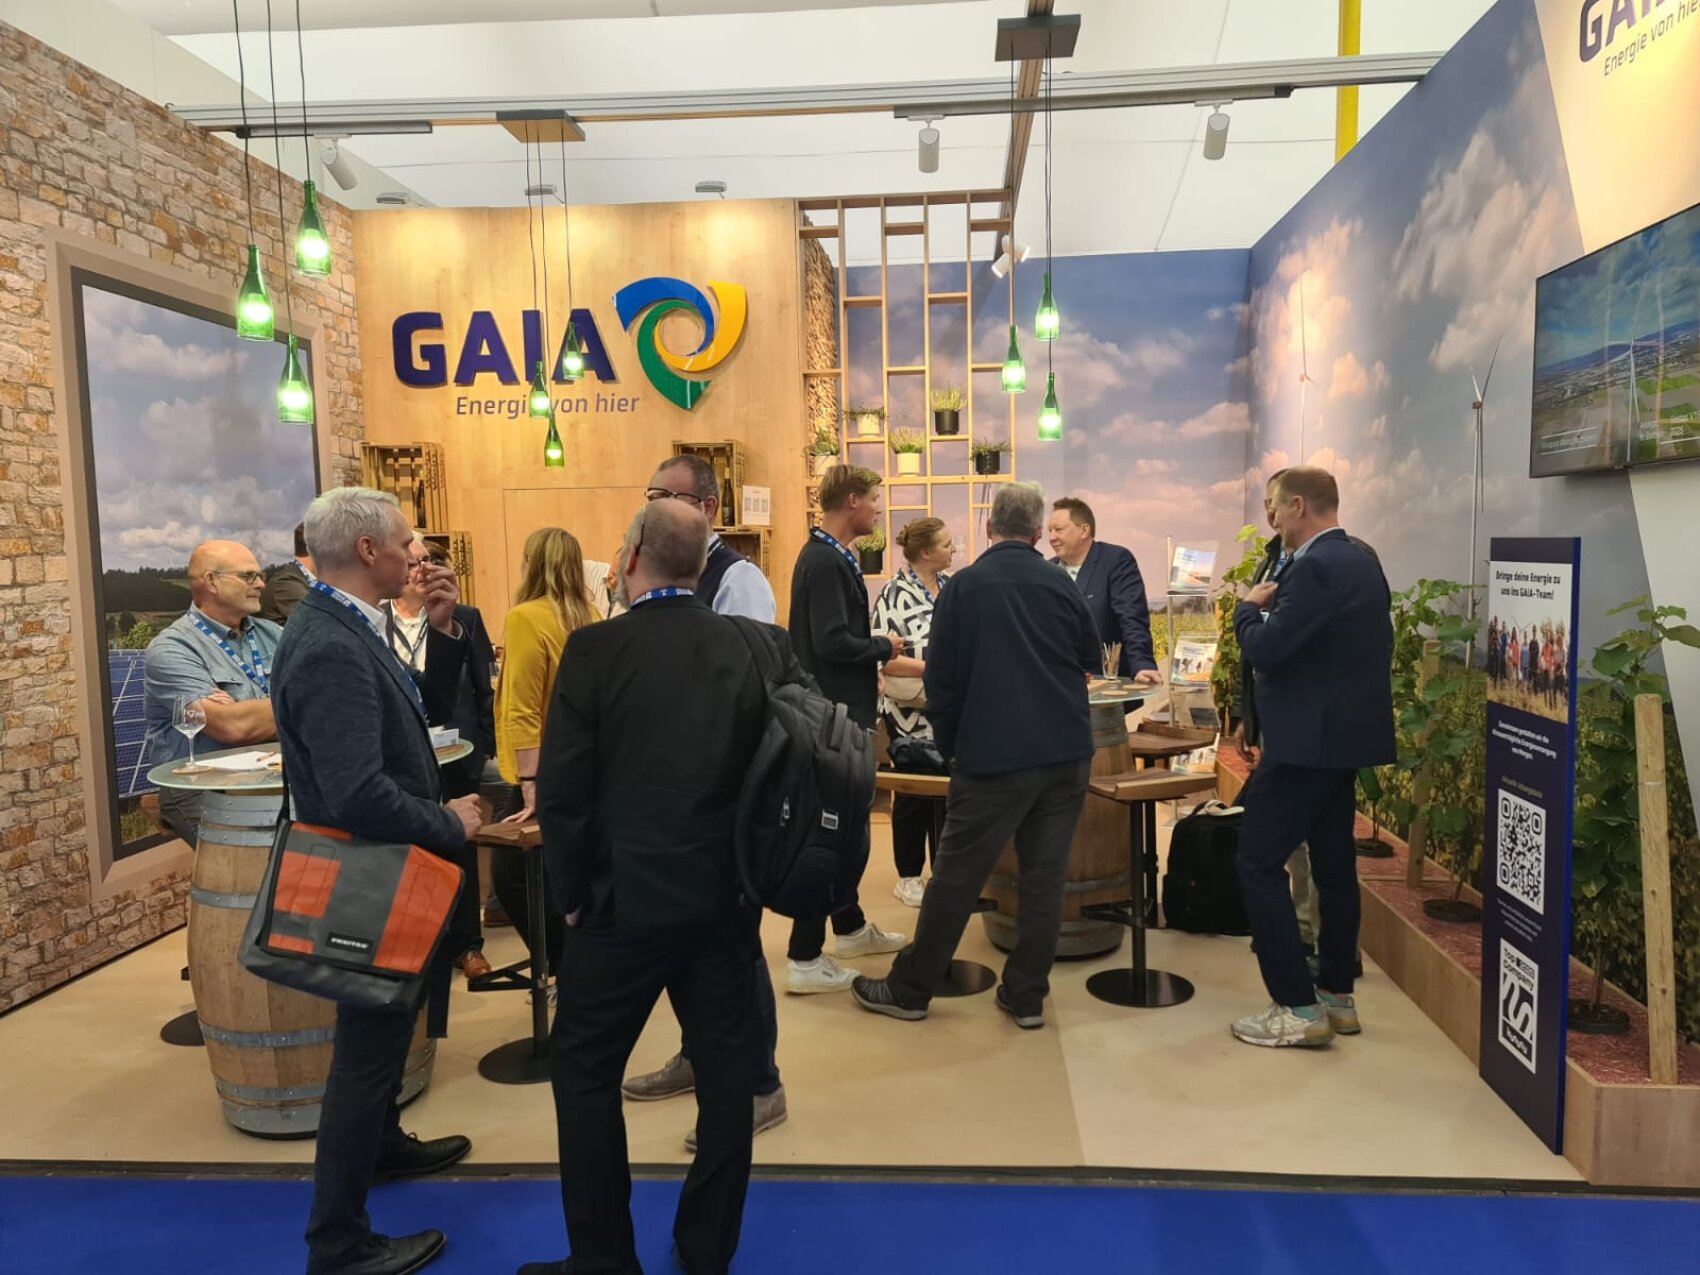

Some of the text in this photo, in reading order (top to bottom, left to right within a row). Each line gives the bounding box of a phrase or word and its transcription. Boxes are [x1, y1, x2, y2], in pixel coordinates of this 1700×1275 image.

[1604, 0, 1700, 76] Energie von hie
[392, 308, 617, 387] GAIA
[456, 394, 528, 419] Energi
[595, 393, 640, 412] hier
[1530, 572, 1552, 586] Energie
